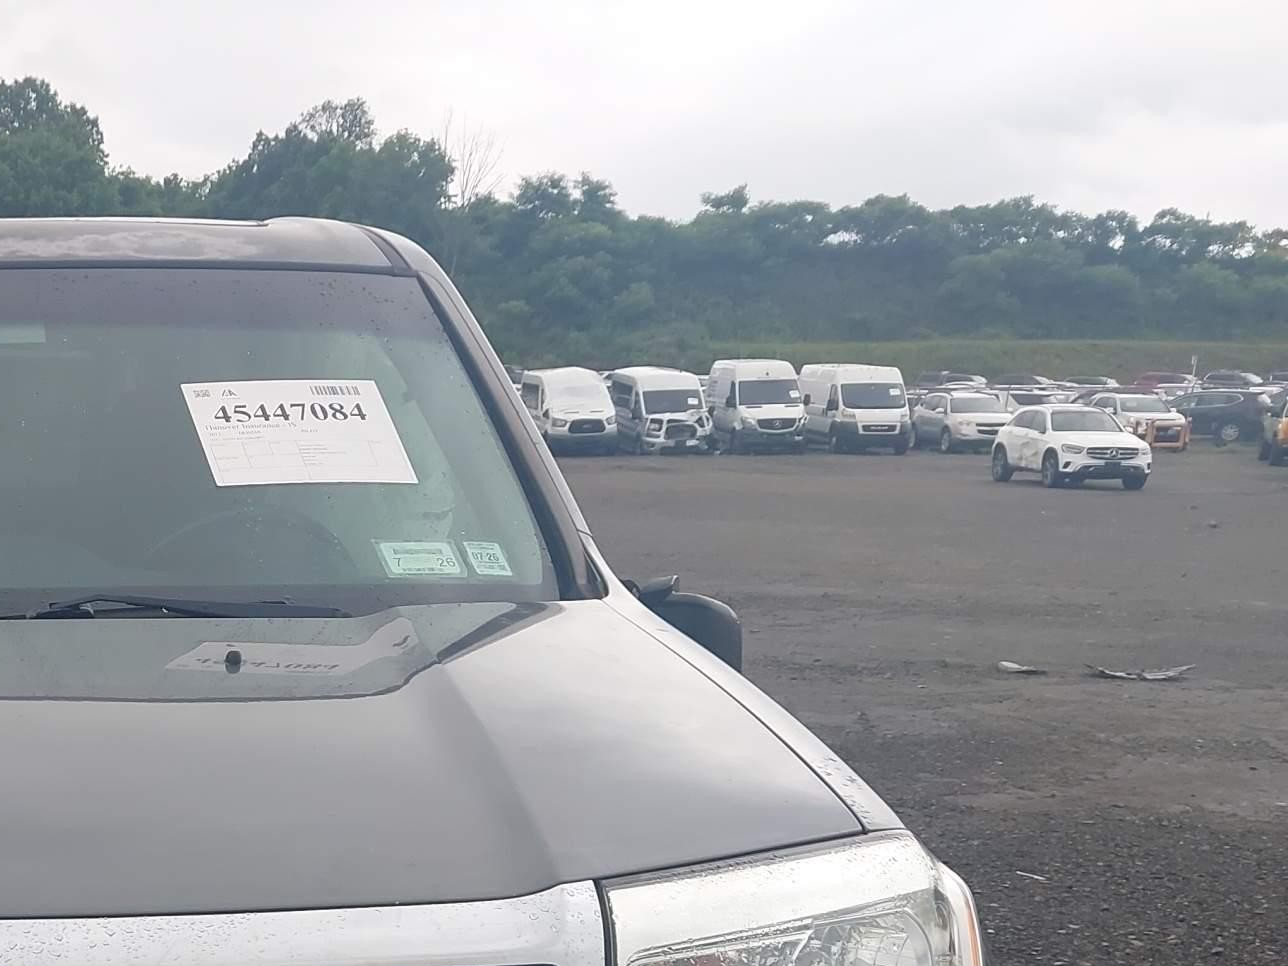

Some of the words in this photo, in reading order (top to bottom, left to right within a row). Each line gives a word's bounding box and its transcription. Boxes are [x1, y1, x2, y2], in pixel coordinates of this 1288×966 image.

[214, 402, 367, 422] 45447084
[392, 557, 401, 567] 7
[436, 557, 456, 567] 26
